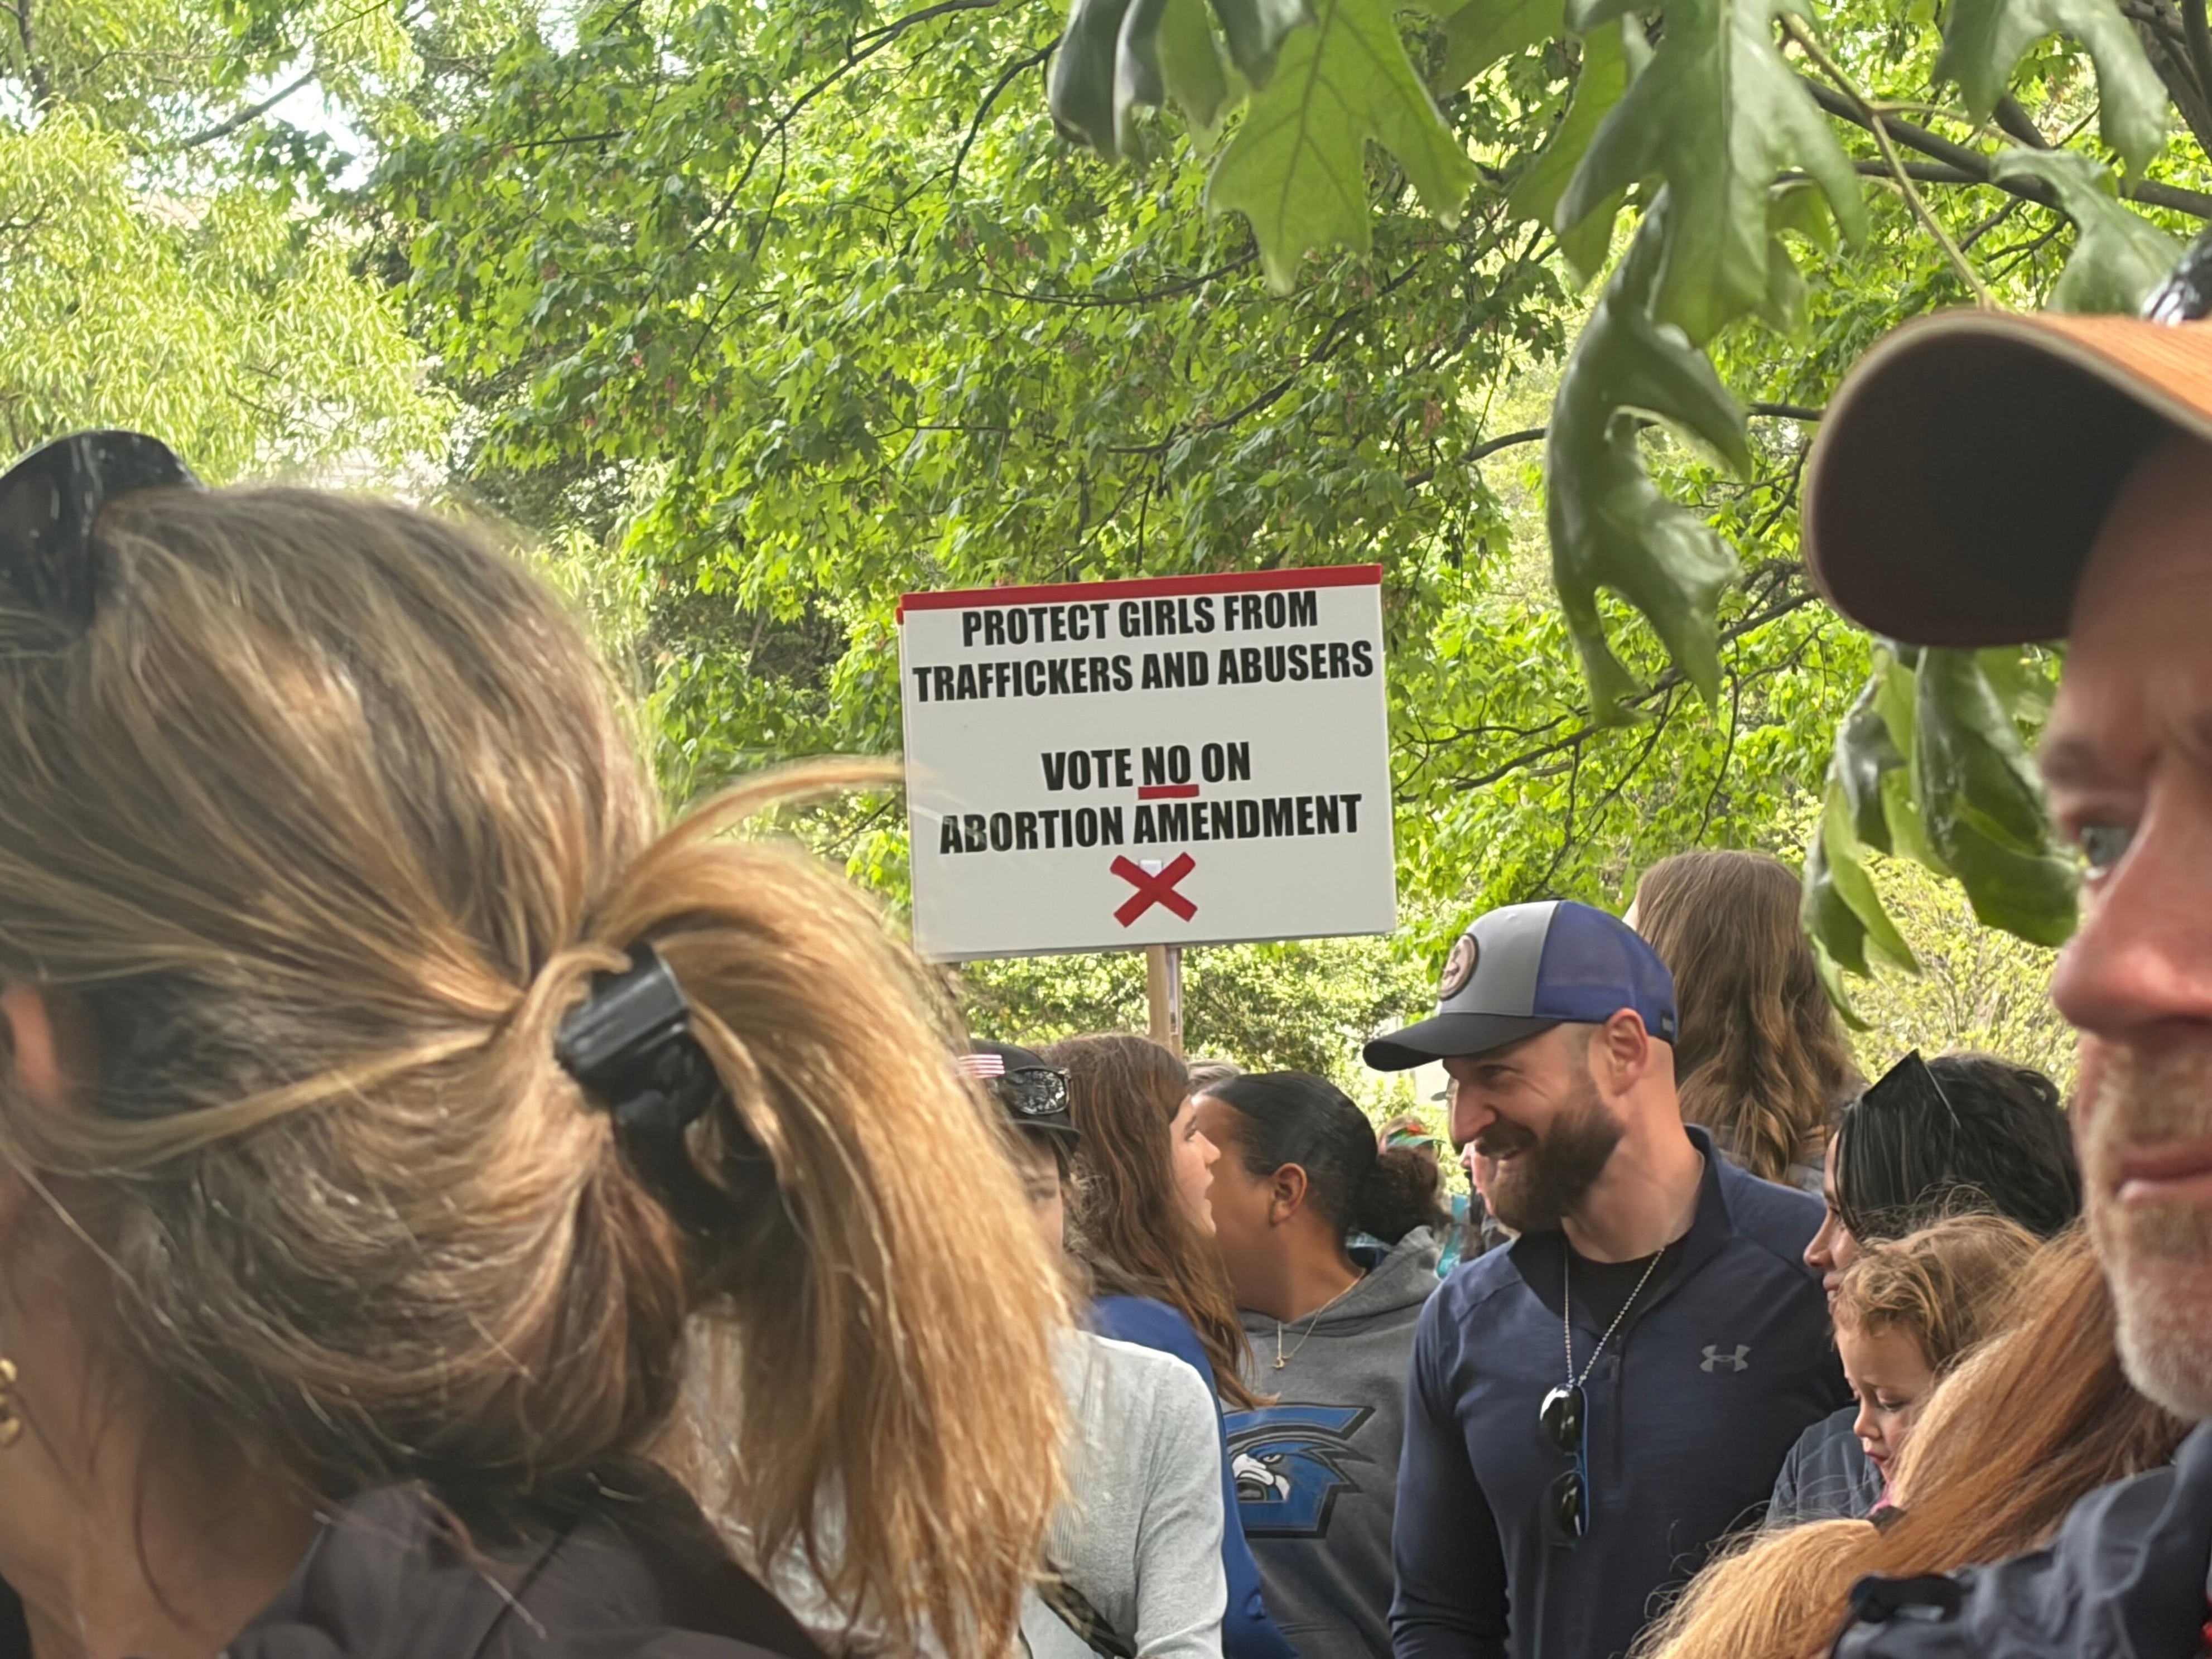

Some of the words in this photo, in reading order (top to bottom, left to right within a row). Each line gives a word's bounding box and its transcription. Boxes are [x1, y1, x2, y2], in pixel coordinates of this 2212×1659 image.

[962, 603, 1110, 647] PROTECT
[1119, 596, 1215, 638] GIRLS
[1223, 590, 1318, 631] FROM
[912, 655, 1133, 702] TRAFFICKERS
[1141, 651, 1209, 689] AND
[1218, 640, 1373, 685] ABUSERS
[1041, 748, 1133, 791] VOTE
[1142, 745, 1191, 785] NO
[1201, 741, 1250, 783] ON
[940, 806, 1124, 854] ABORTION
[1133, 793, 1362, 844] AMENDMENT
